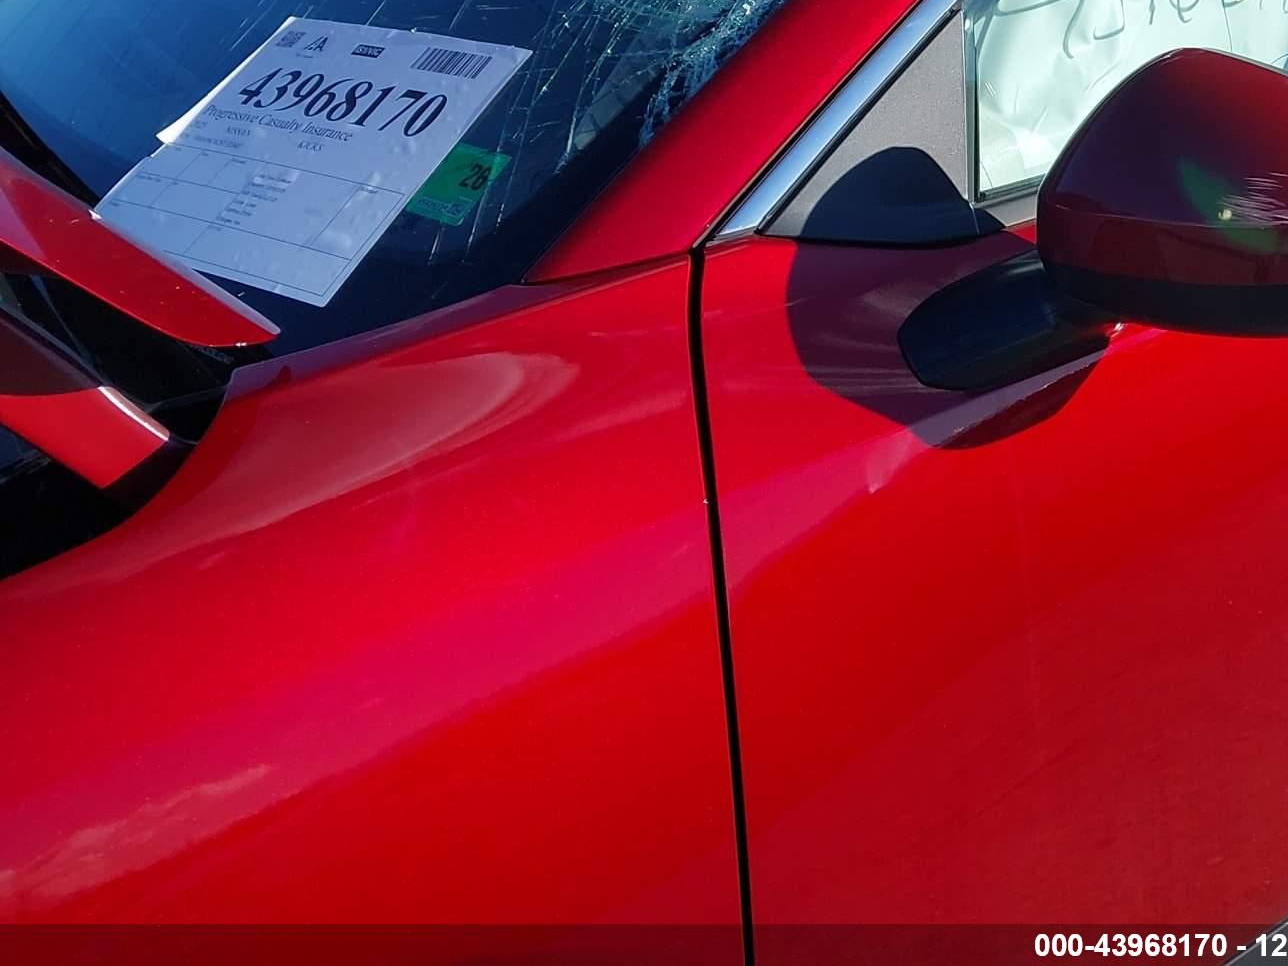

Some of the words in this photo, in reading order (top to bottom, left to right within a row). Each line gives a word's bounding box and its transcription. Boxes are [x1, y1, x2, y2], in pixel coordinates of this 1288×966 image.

[203, 104, 259, 123] Progressive
[258, 114, 302, 134] Casualty
[302, 122, 354, 142] Insurance
[239, 67, 448, 137] 43968170
